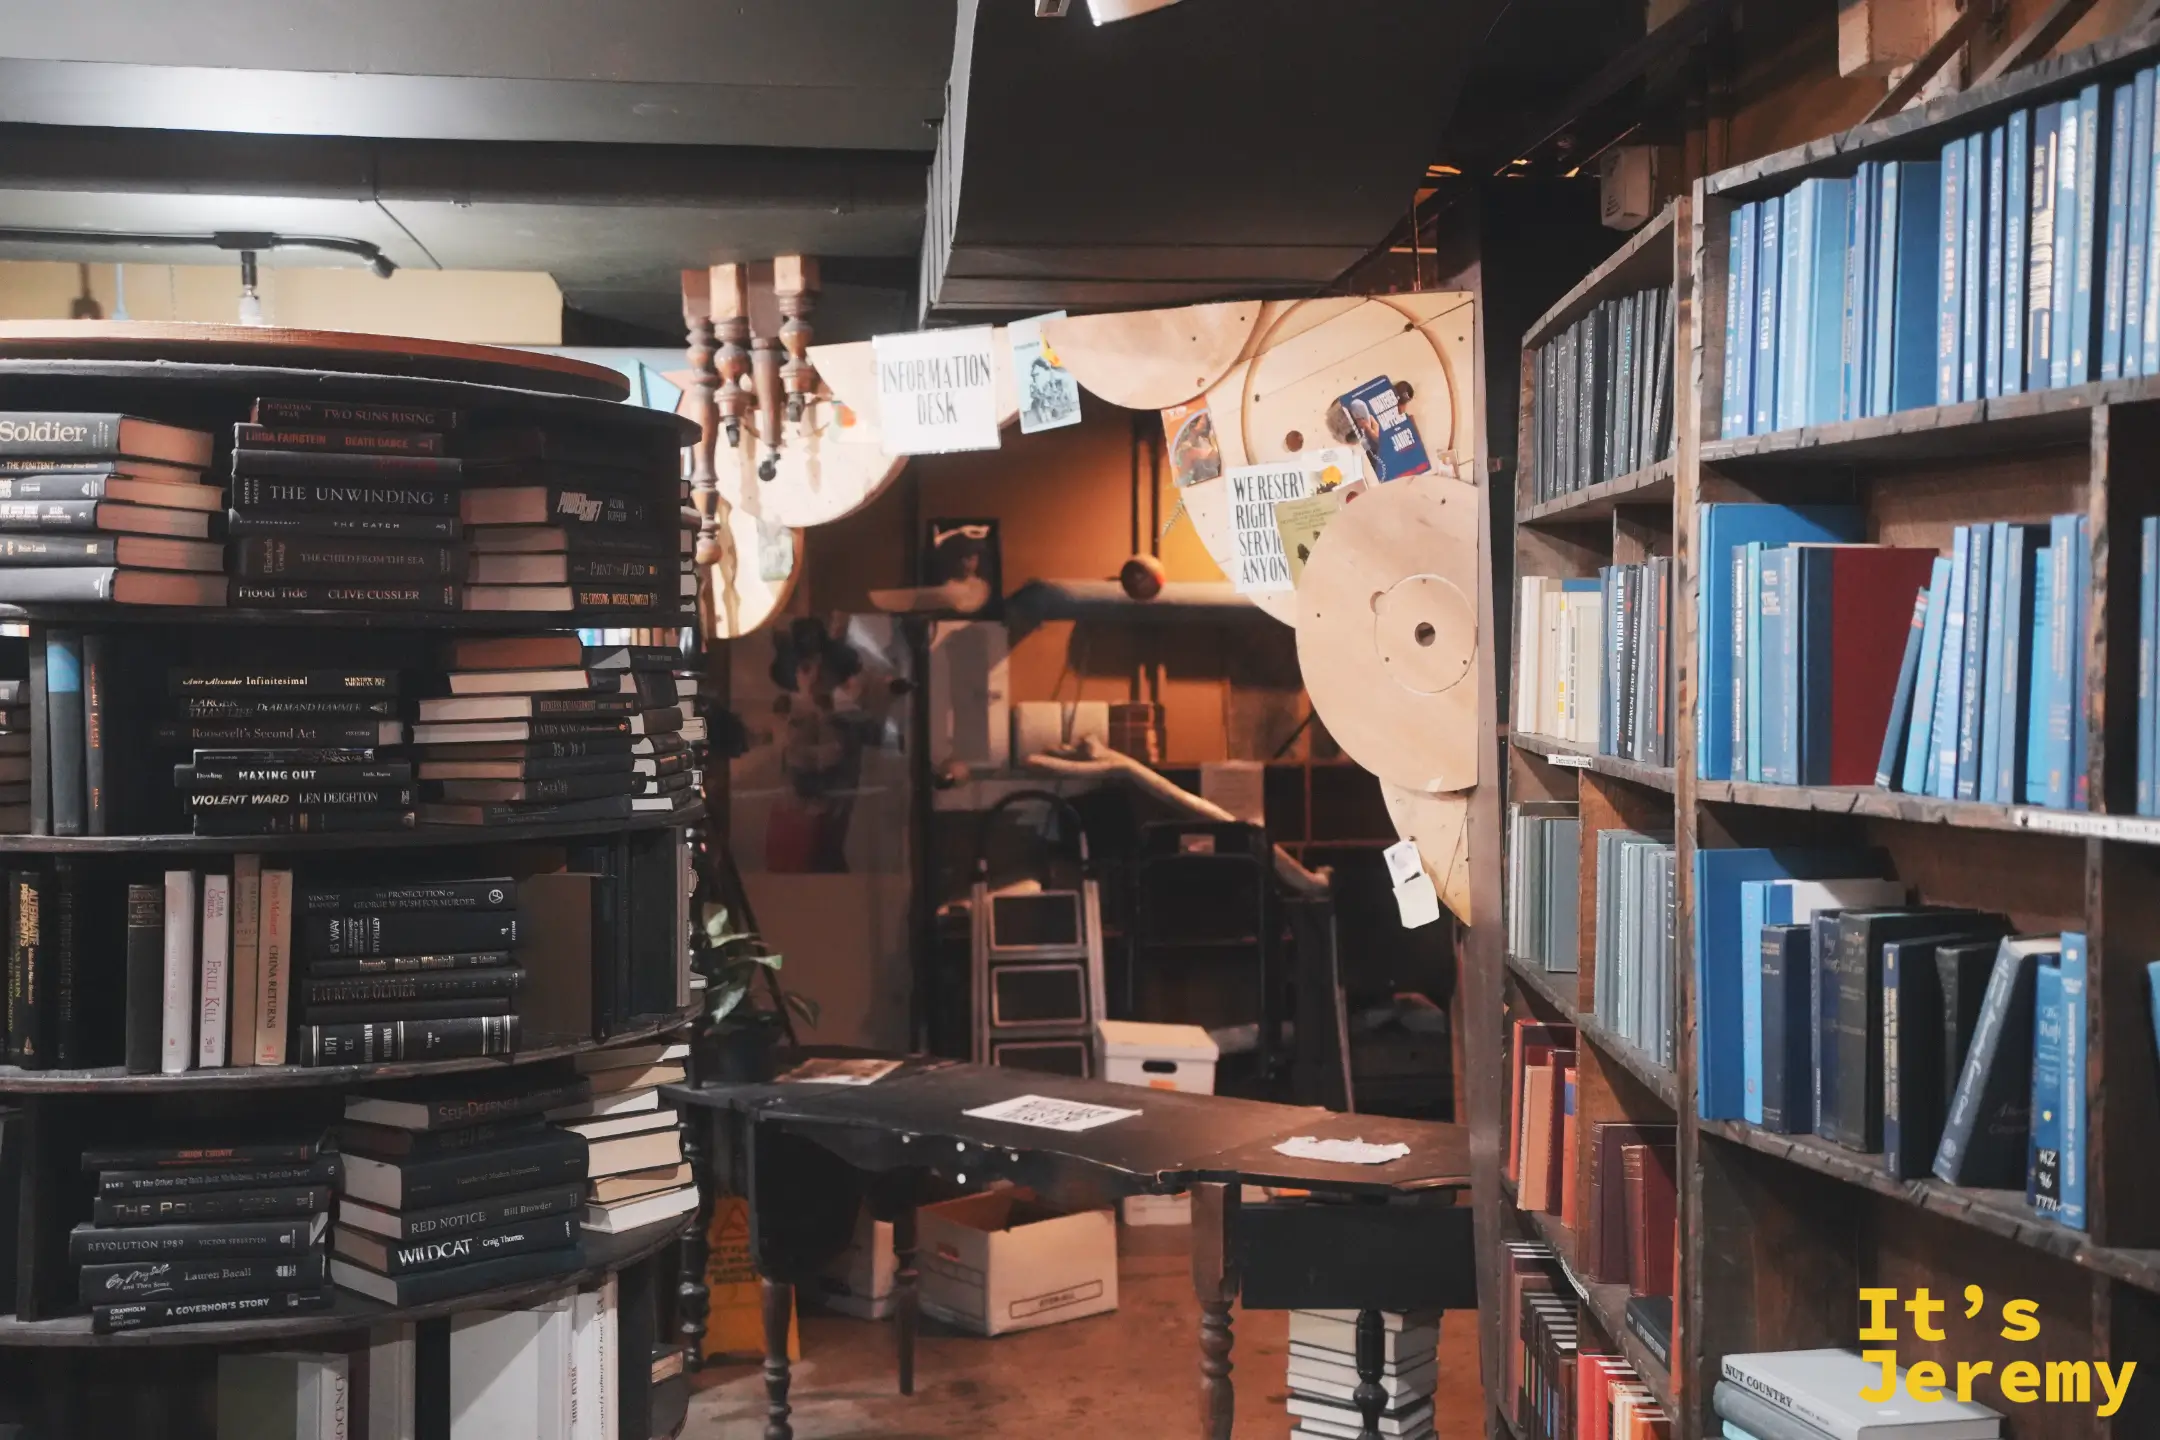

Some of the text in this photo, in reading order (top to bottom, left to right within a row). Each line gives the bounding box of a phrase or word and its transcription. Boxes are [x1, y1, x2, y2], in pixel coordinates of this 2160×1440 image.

[1759, 288, 1772, 350] THE CLUB
[882, 352, 991, 393] INFORMATION
[323, 408, 352, 420] TWO
[355, 410, 389, 422] SUNS
[391, 411, 435, 424] RISING
[917, 391, 958, 425] DESK
[0, 420, 88, 442] Soldier
[277, 432, 326, 445] FAIRSTEIN
[269, 484, 434, 505] THE UNWINDING
[1233, 475, 1256, 503] WE
[333, 521, 355, 529] THE
[1235, 502, 1276, 530] RIGHT
[300, 552, 320, 563] THE
[355, 554, 385, 564] FROM
[407, 556, 425, 565] SEA
[238, 586, 420, 600] Flood Tide CLIVE CUSSLER
[1616, 589, 1624, 651] BILLINGHAM
[205, 677, 242, 686] Alexander
[246, 676, 308, 686] Infinitesimal
[192, 727, 317, 740] Roosevelt's Second Act
[238, 770, 289, 781] MAXING
[292, 770, 317, 780] OUT
[191, 791, 379, 805] VIOLENT WARD LEN DEIGHTON
[215, 889, 226, 918] LAURA
[353, 900, 388, 910] GEORGE
[422, 898, 439, 908] FOR
[439, 897, 477, 908] MURDER
[388, 889, 447, 899] PROSECUTION
[28, 888, 40, 947] ALTERNATE
[329, 918, 340, 942] WAY
[204, 888, 222, 1025] CHILDS FRILL KILL
[268, 945, 279, 978] CHINA
[312, 985, 370, 1003] LAURENCE
[372, 984, 416, 1001] OLIVIER
[266, 980, 278, 1029] RETURNS
[439, 1097, 519, 1123] SELF-DEFENSE
[155, 1178, 174, 1187] Other
[175, 1178, 188, 1187] Guy
[112, 1203, 152, 1217] THE
[411, 1200, 553, 1234] RED NOTICE Bill Browder
[88, 1239, 158, 1252] REVOLUTION
[162, 1238, 184, 1249] 1989
[198, 1236, 227, 1246] VICTOR
[397, 1233, 525, 1267] WILDCAT Craig Thomas
[184, 1271, 221, 1281] Lauren
[222, 1268, 252, 1279] Bacall
[122, 1283, 135, 1291] and
[137, 1282, 152, 1290] Then
[165, 1308, 174, 1316] A
[176, 1302, 237, 1316] GOVERNOR'S
[239, 1298, 270, 1309] STORY
[1725, 1363, 1793, 1408] NUT COUNTRY
